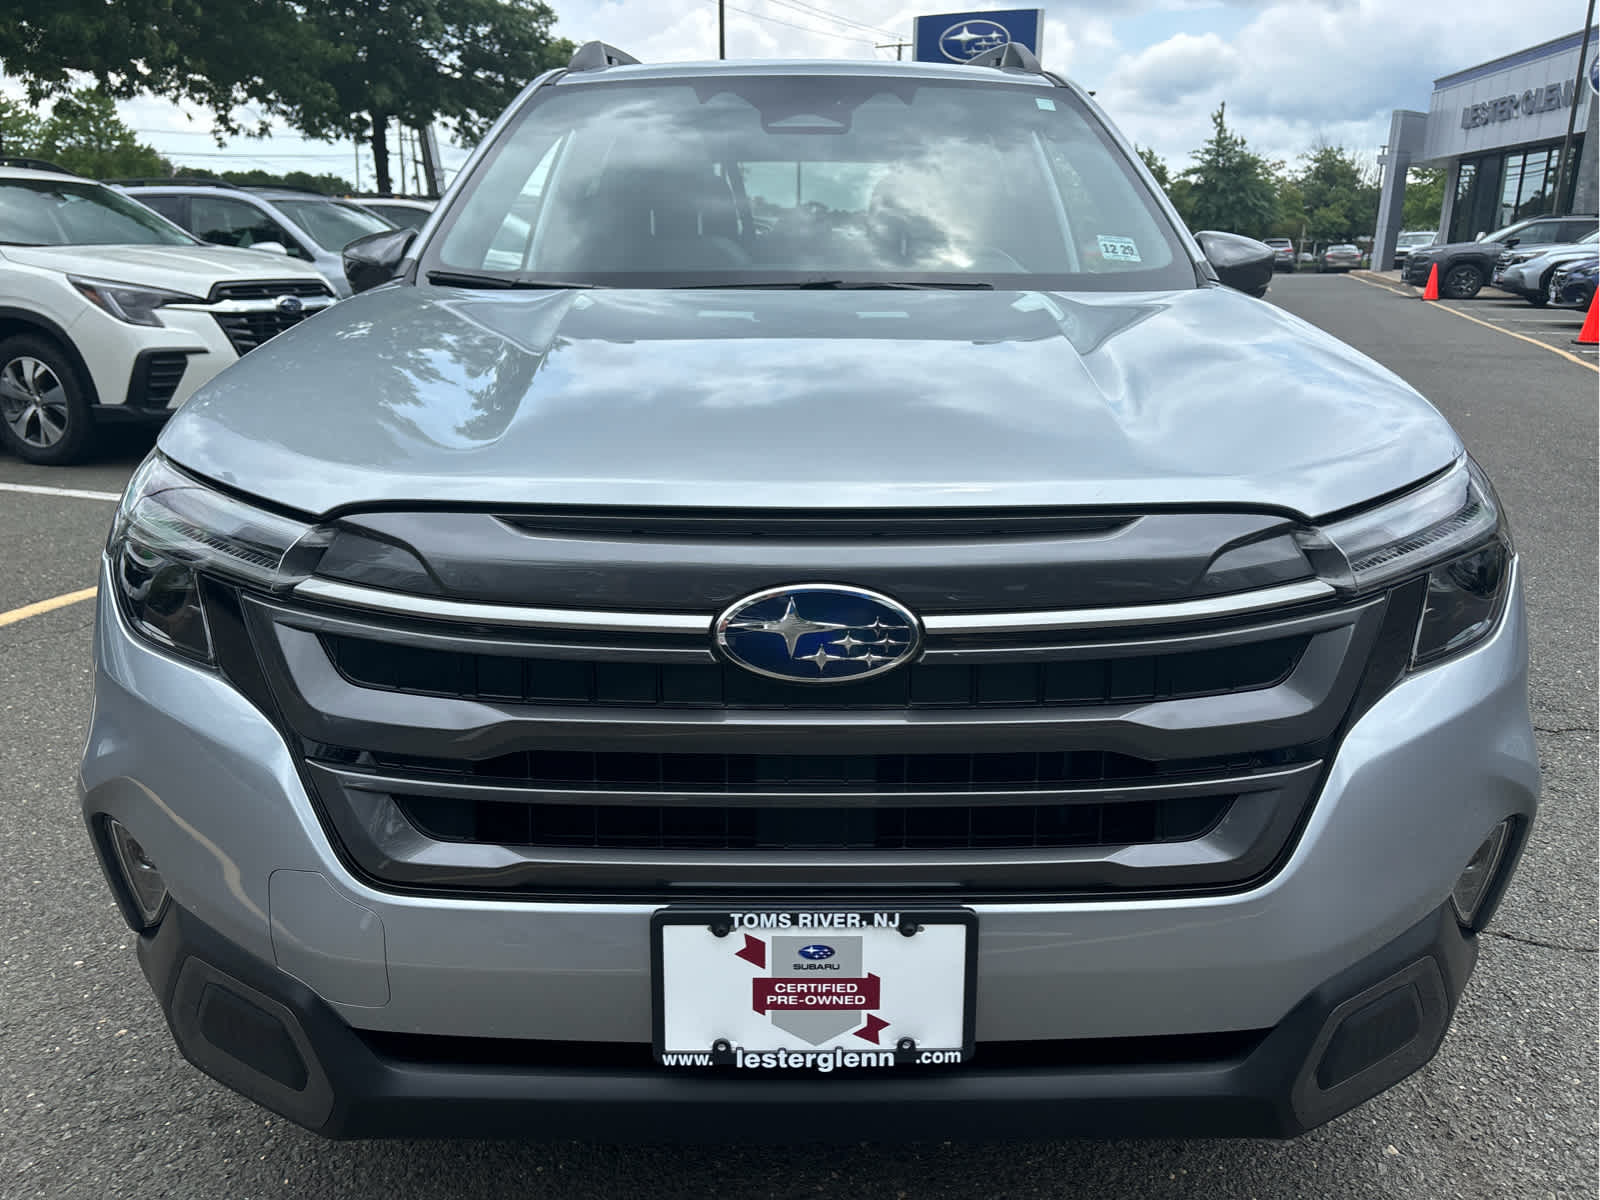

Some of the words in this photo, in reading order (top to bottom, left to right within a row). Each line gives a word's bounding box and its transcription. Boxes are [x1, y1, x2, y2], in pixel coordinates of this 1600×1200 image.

[1461, 95, 1519, 129] LESTER
[1103, 243, 1119, 254] 12
[1119, 244, 1135, 256] 29
[730, 912, 792, 929] TOMS
[798, 912, 867, 929] RIVER,
[873, 912, 900, 929] NJ
[793, 963, 841, 971] SUBARU
[774, 983, 858, 993] CERTIFIED
[766, 995, 866, 1006] PRE-OWNED
[662, 1053, 714, 1066] www.
[736, 1048, 895, 1073] lesterglenn
[915, 1050, 962, 1065] .com
